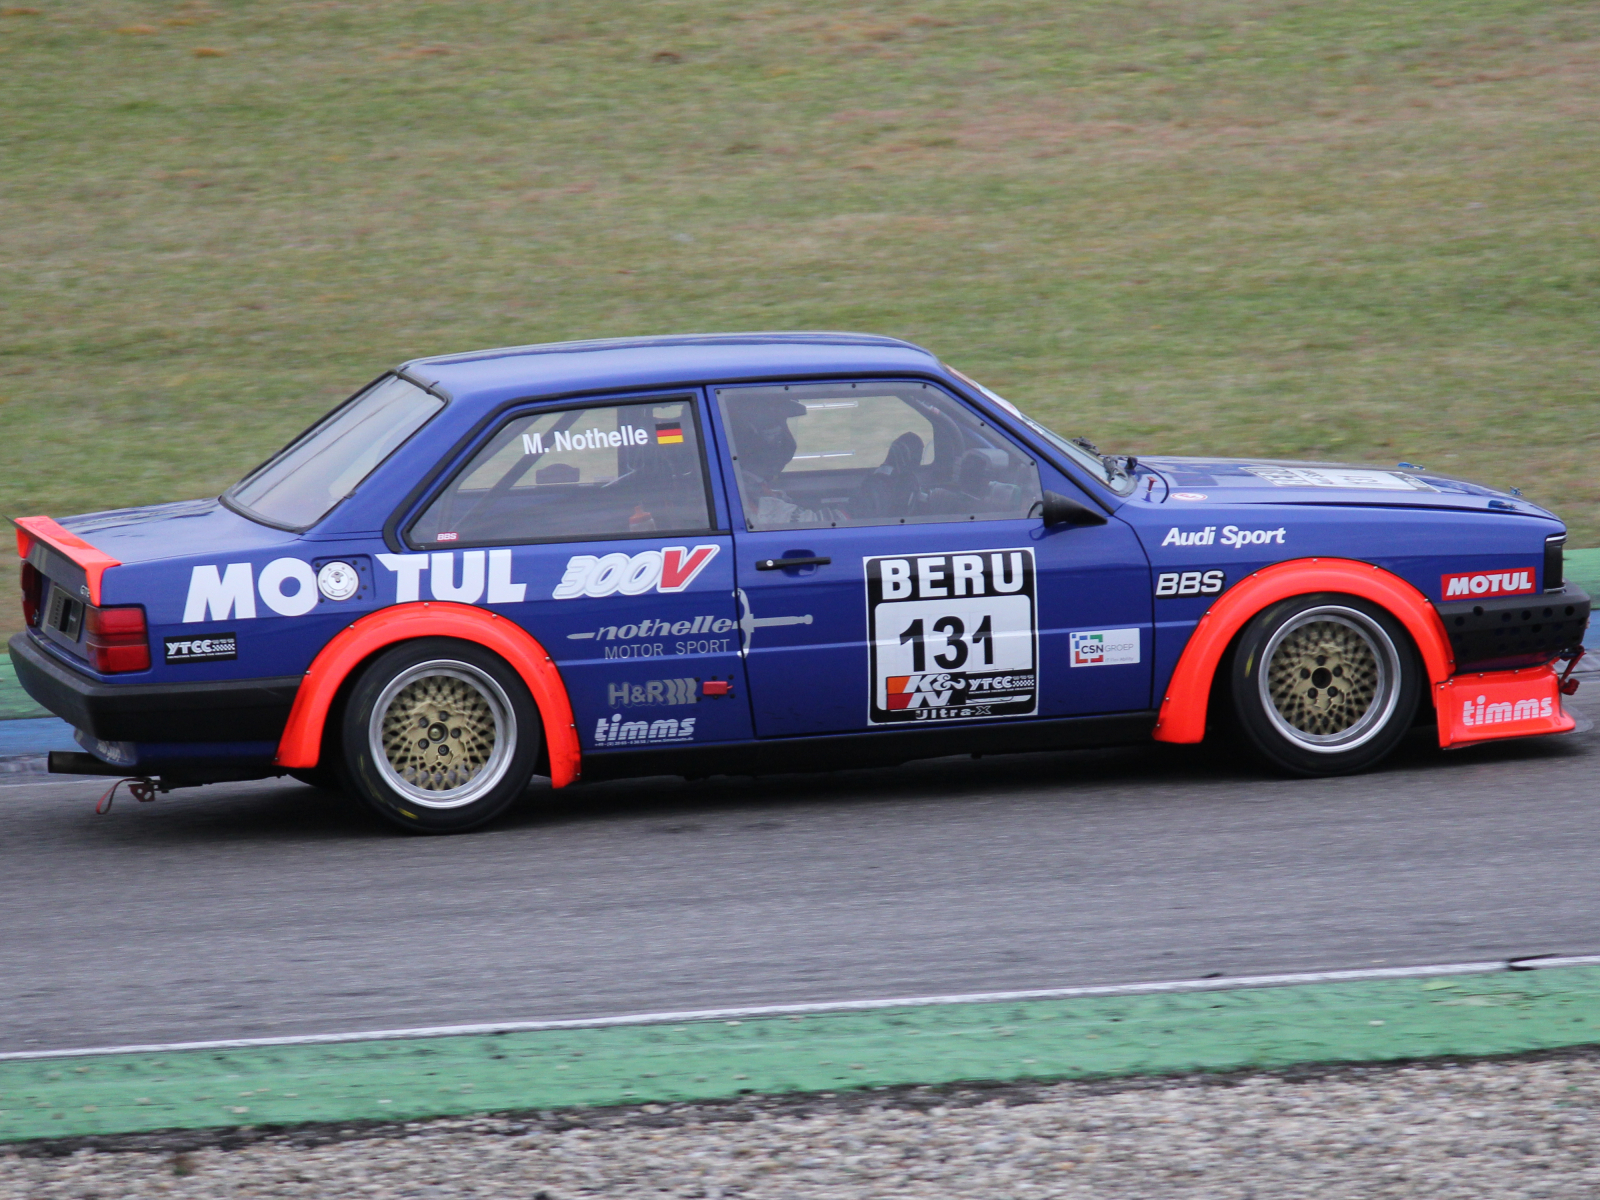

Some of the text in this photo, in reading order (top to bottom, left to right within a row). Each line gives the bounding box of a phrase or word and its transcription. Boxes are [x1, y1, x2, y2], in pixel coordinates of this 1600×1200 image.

[522, 425, 649, 455] M. Nothelle
[436, 532, 458, 541] BBS
[1161, 525, 1287, 549] Audi Sport
[552, 544, 721, 600] 300V
[879, 552, 1025, 600] BERU
[1155, 569, 1225, 597] BBS
[1446, 571, 1533, 597] MOTUL
[595, 615, 733, 641] nothelle
[165, 639, 213, 655] YTCC
[604, 639, 730, 660] MOTOR SPORT
[899, 614, 994, 673] 131
[608, 682, 664, 706] H&R
[968, 675, 1013, 691] YTCC
[915, 705, 992, 720] Ultra-X
[1462, 695, 1554, 727] timms
[594, 713, 697, 742] timms
